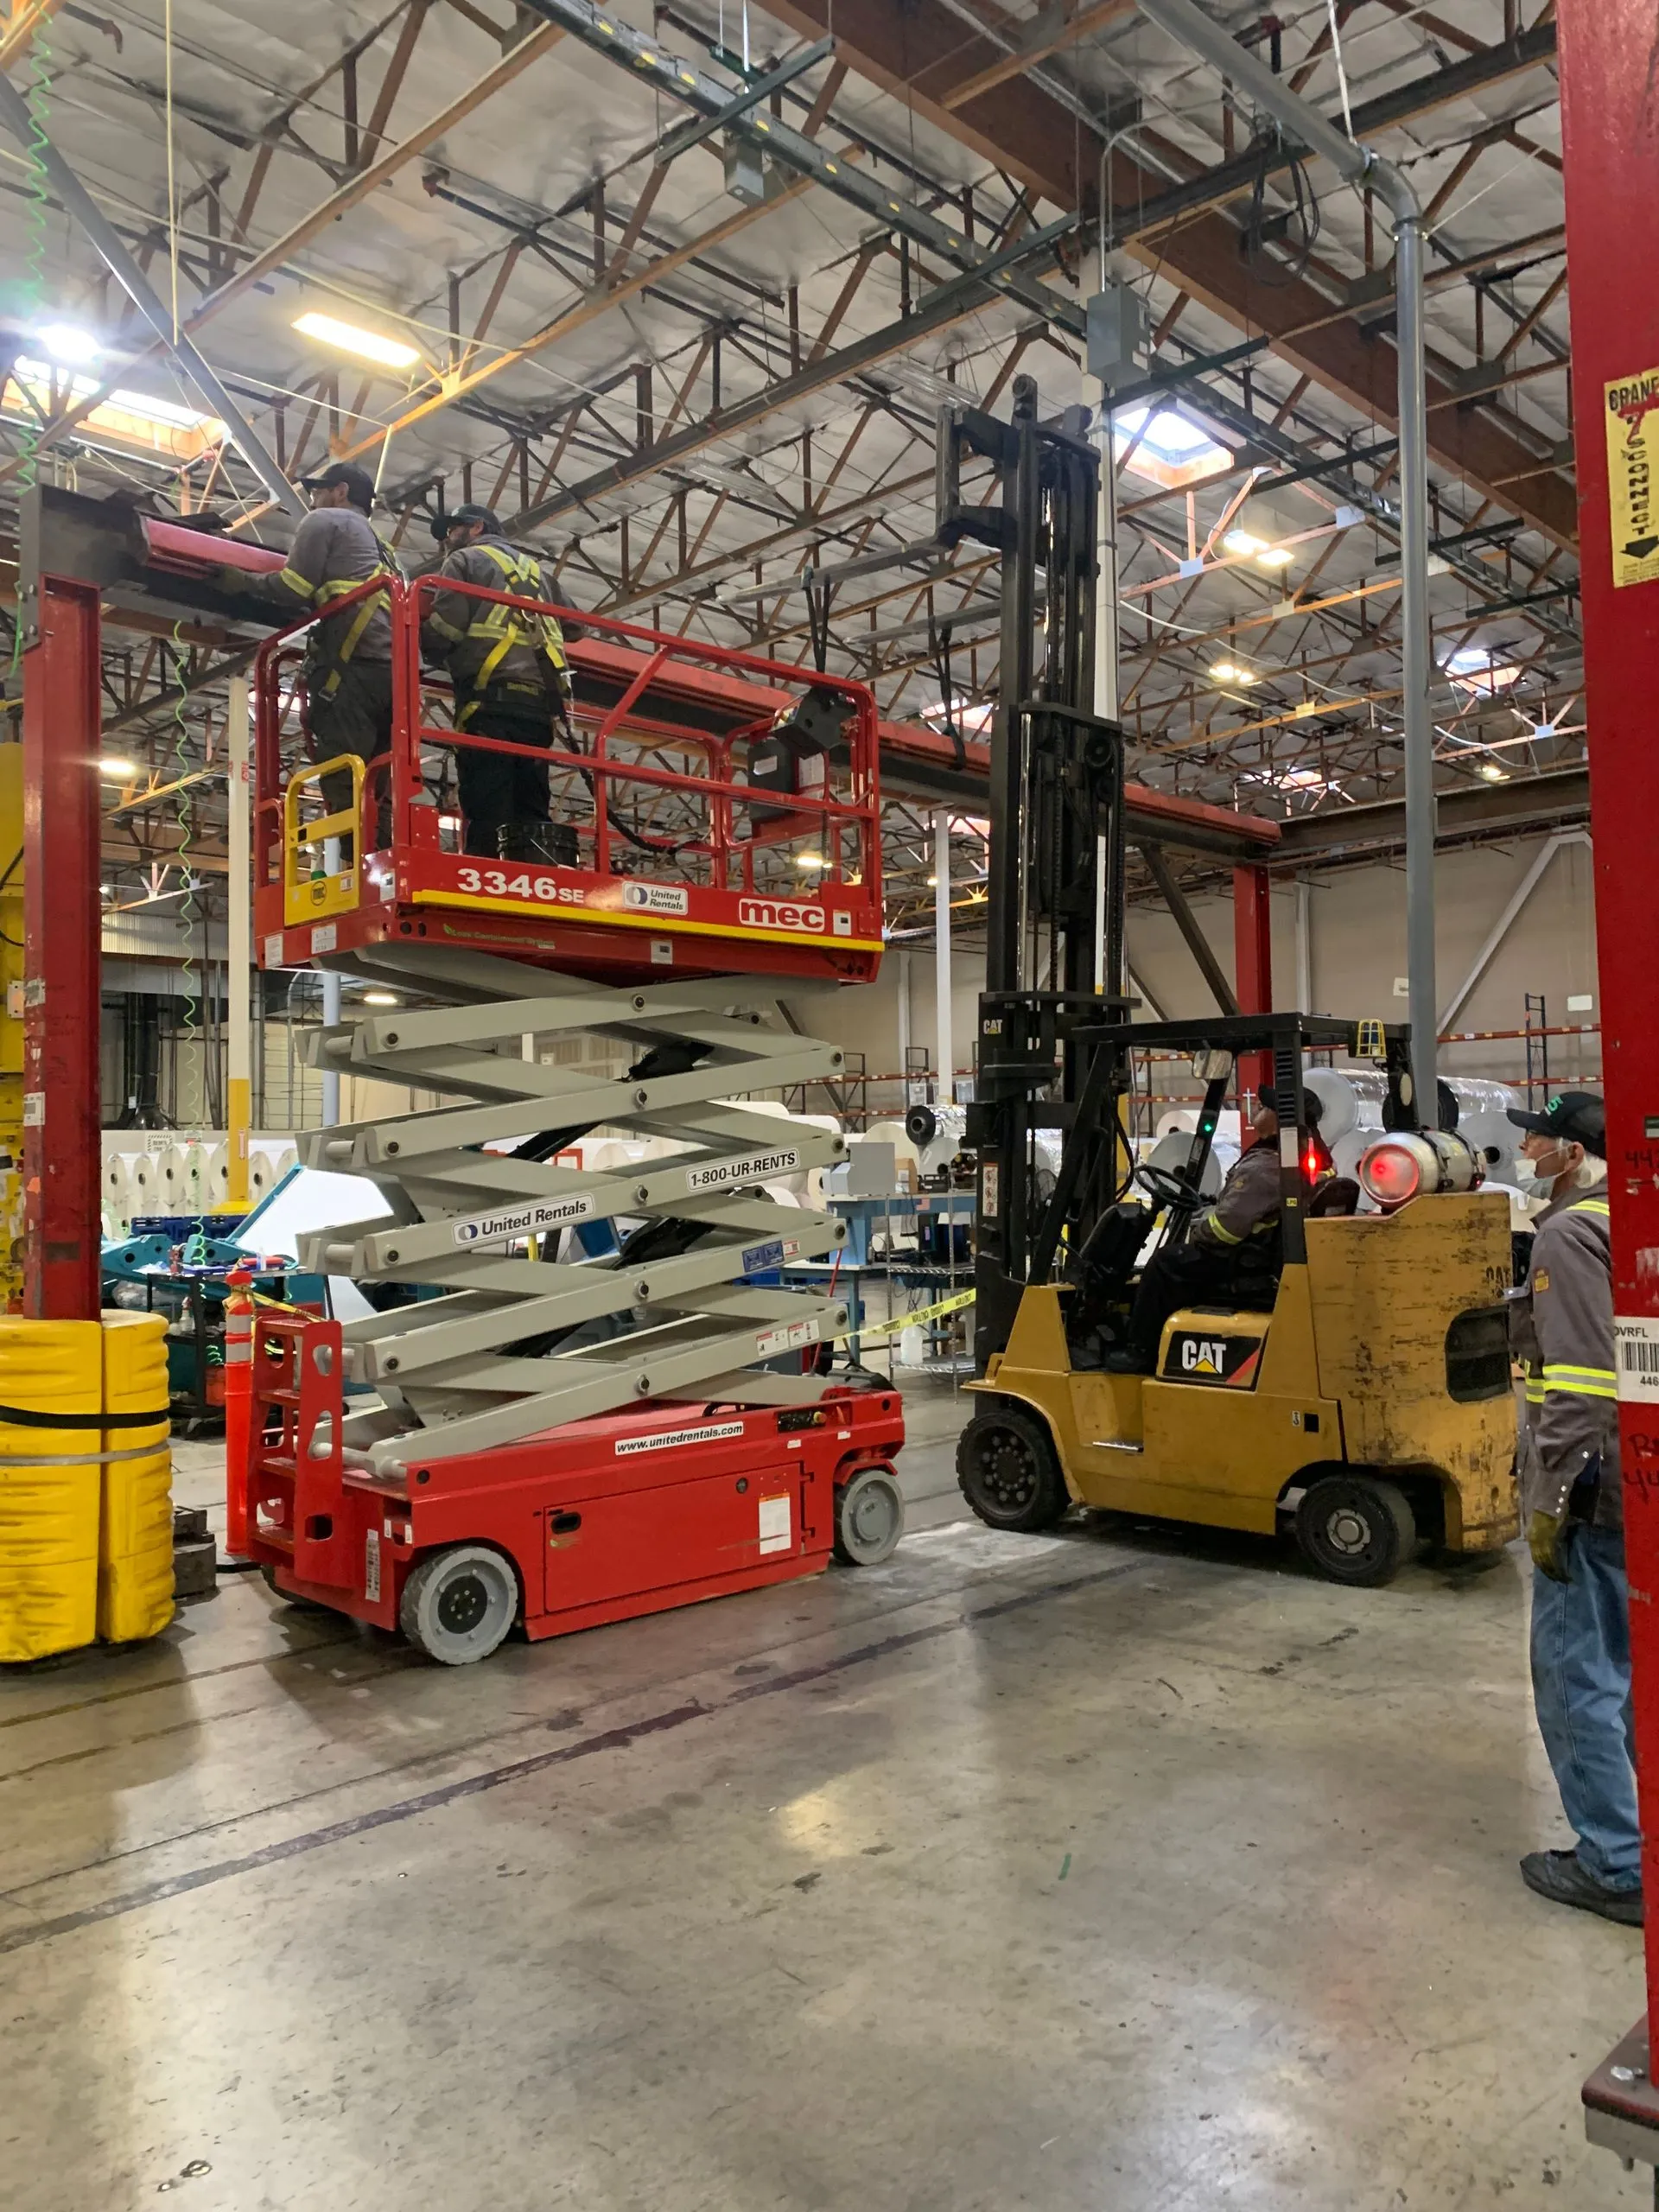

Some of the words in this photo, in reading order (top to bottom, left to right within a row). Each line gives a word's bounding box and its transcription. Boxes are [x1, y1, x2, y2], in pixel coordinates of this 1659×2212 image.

[649, 898, 683, 911] Rentals
[650, 889, 682, 901] United
[741, 902, 823, 929] mec
[983, 1019, 1002, 1035] CAT
[691, 1152, 795, 1186] 1-800-UR-RENTS
[481, 1211, 531, 1236] United
[535, 1200, 587, 1224] Rentals
[1182, 1339, 1227, 1375] CAT
[617, 1425, 743, 1452] www.unitedrentals.com
